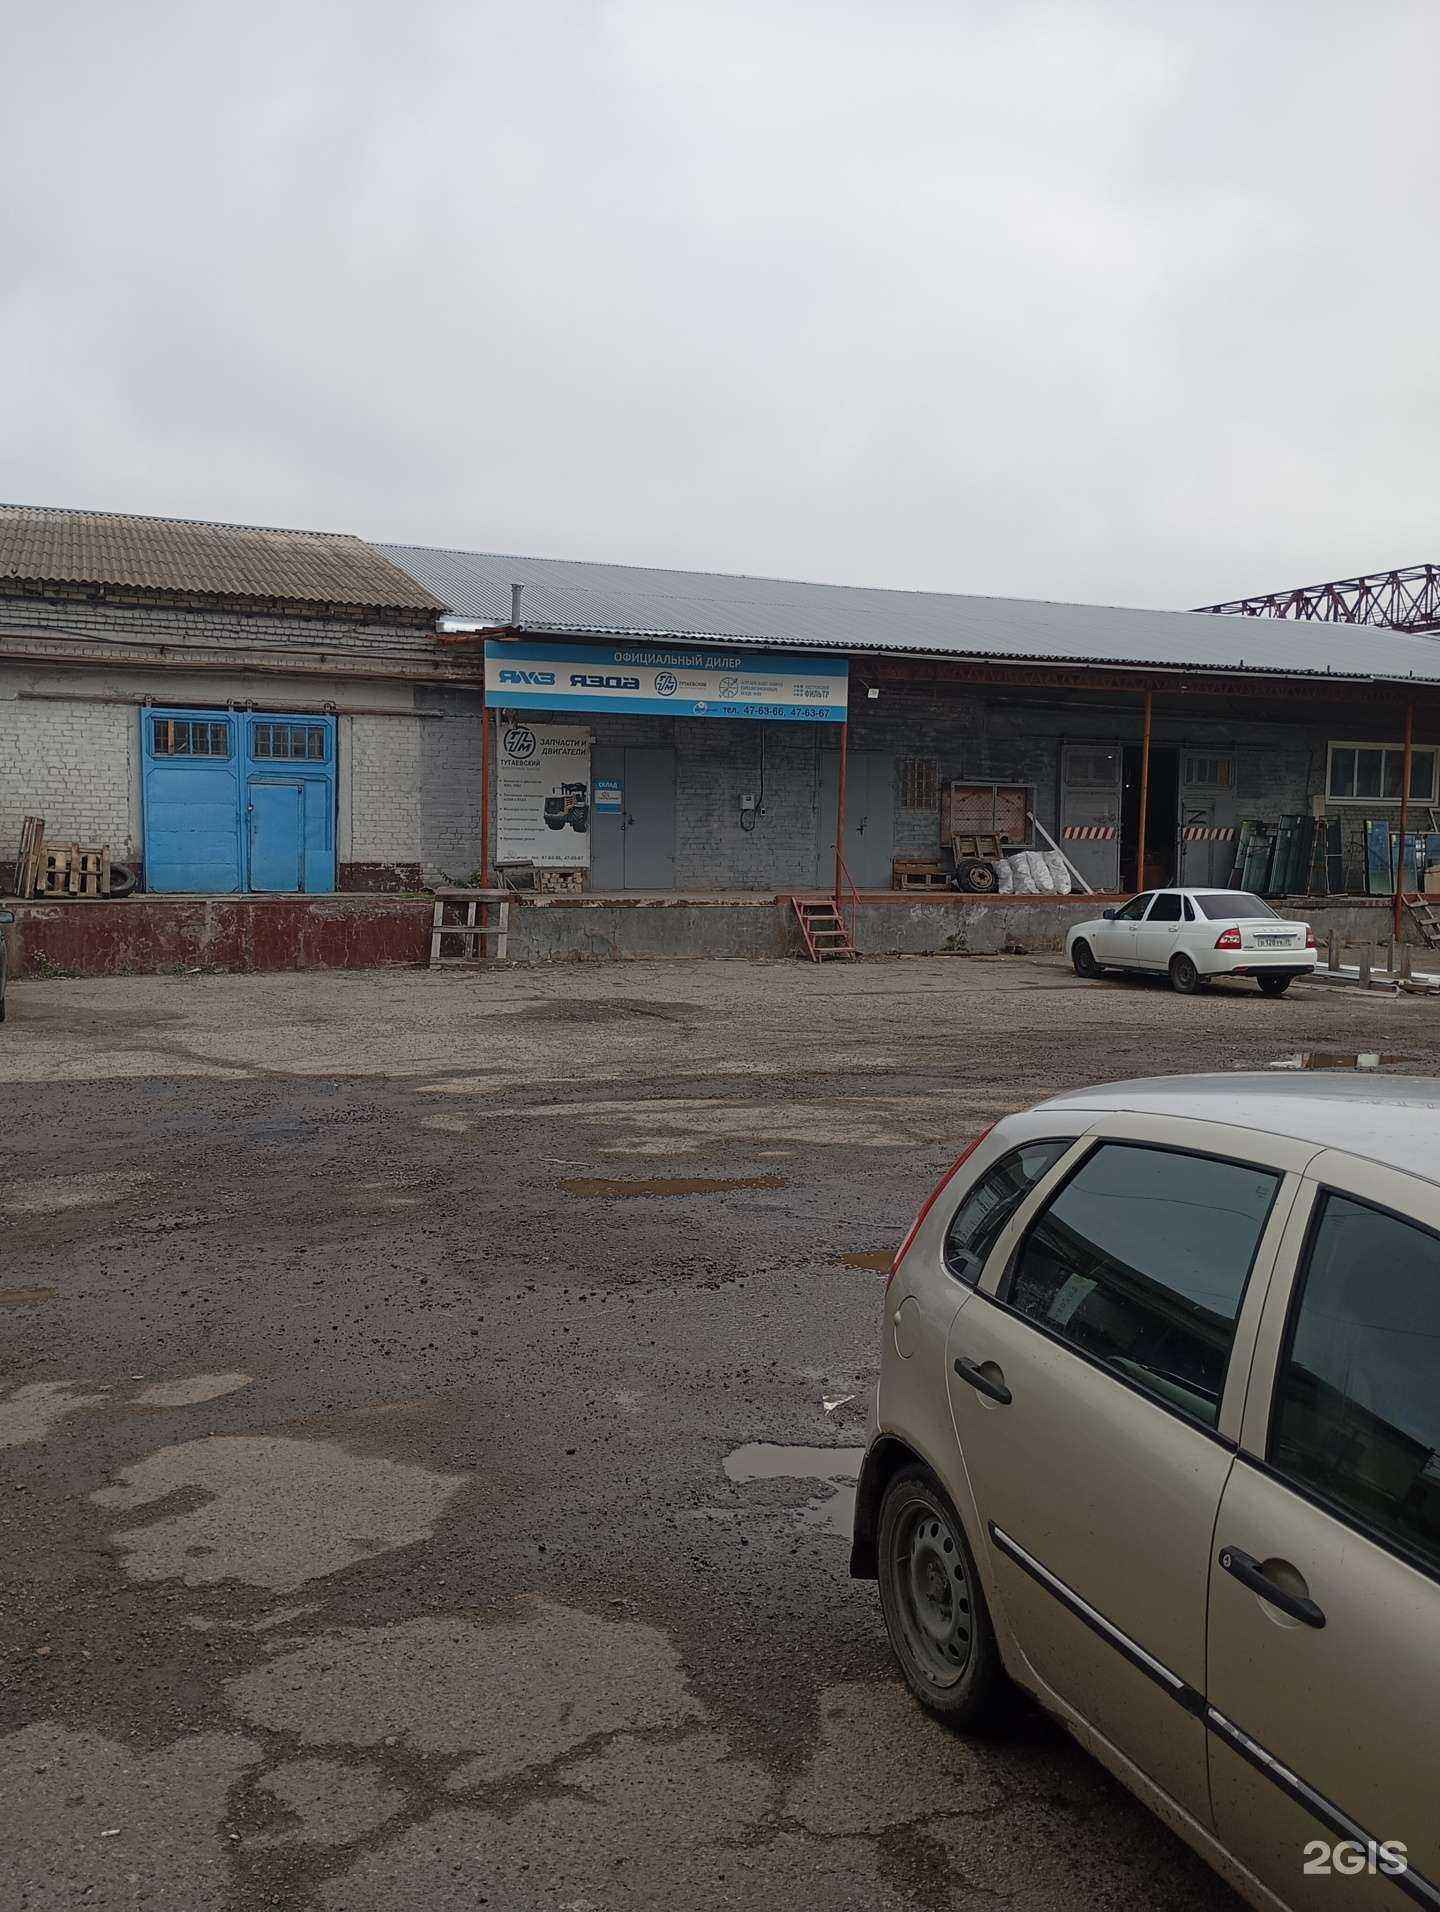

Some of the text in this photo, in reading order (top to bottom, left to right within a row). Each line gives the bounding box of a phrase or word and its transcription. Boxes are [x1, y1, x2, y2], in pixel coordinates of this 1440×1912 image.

[614, 651, 742, 669] ОФИЦИАЛЬНЫЙ ДИЛЕР
[723, 706, 740, 714] тел.
[540, 738, 580, 747] ЗАПЧАСТИ
[542, 747, 587, 756] ДВИГАТЕЛИ
